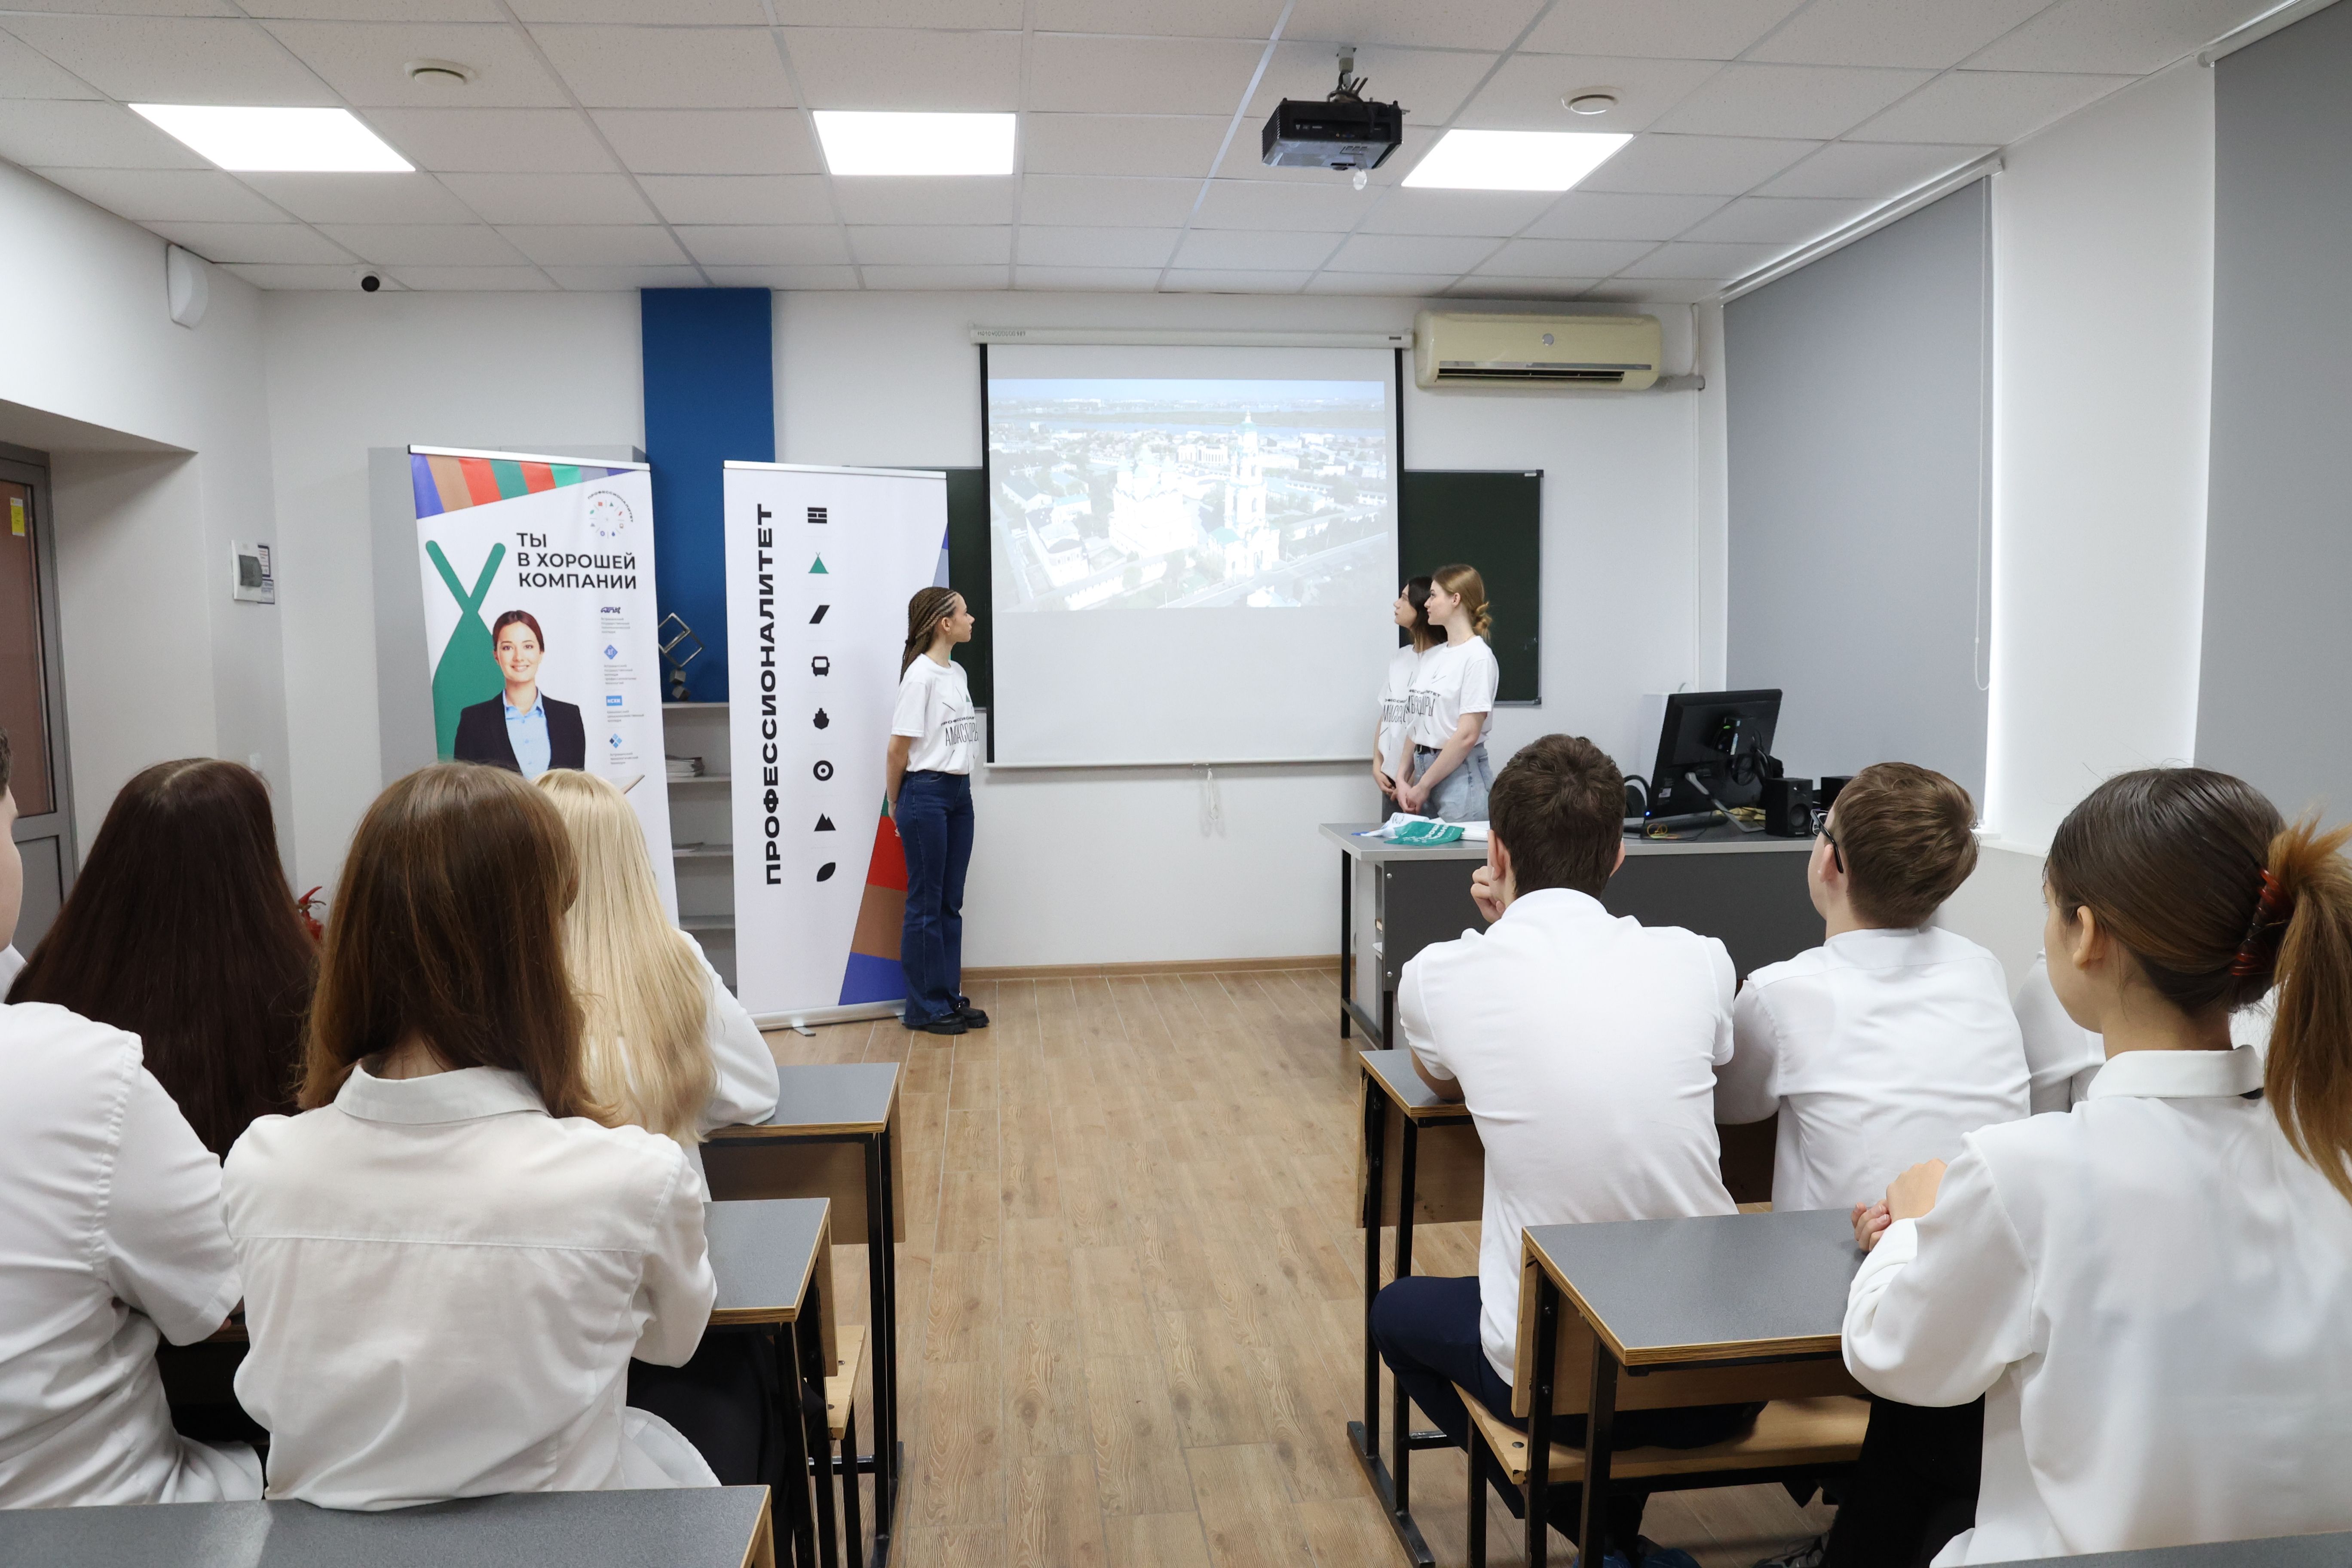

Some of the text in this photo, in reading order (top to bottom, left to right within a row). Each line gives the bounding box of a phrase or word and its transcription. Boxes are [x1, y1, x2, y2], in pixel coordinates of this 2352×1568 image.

[516, 533, 546, 548] ТЫ
[518, 552, 635, 570] В ХОРОШЕЙ
[519, 573, 636, 589] КОМПАНИИ
[757, 504, 781, 885] ПРОФЕССИОНАЛИТЕТ
